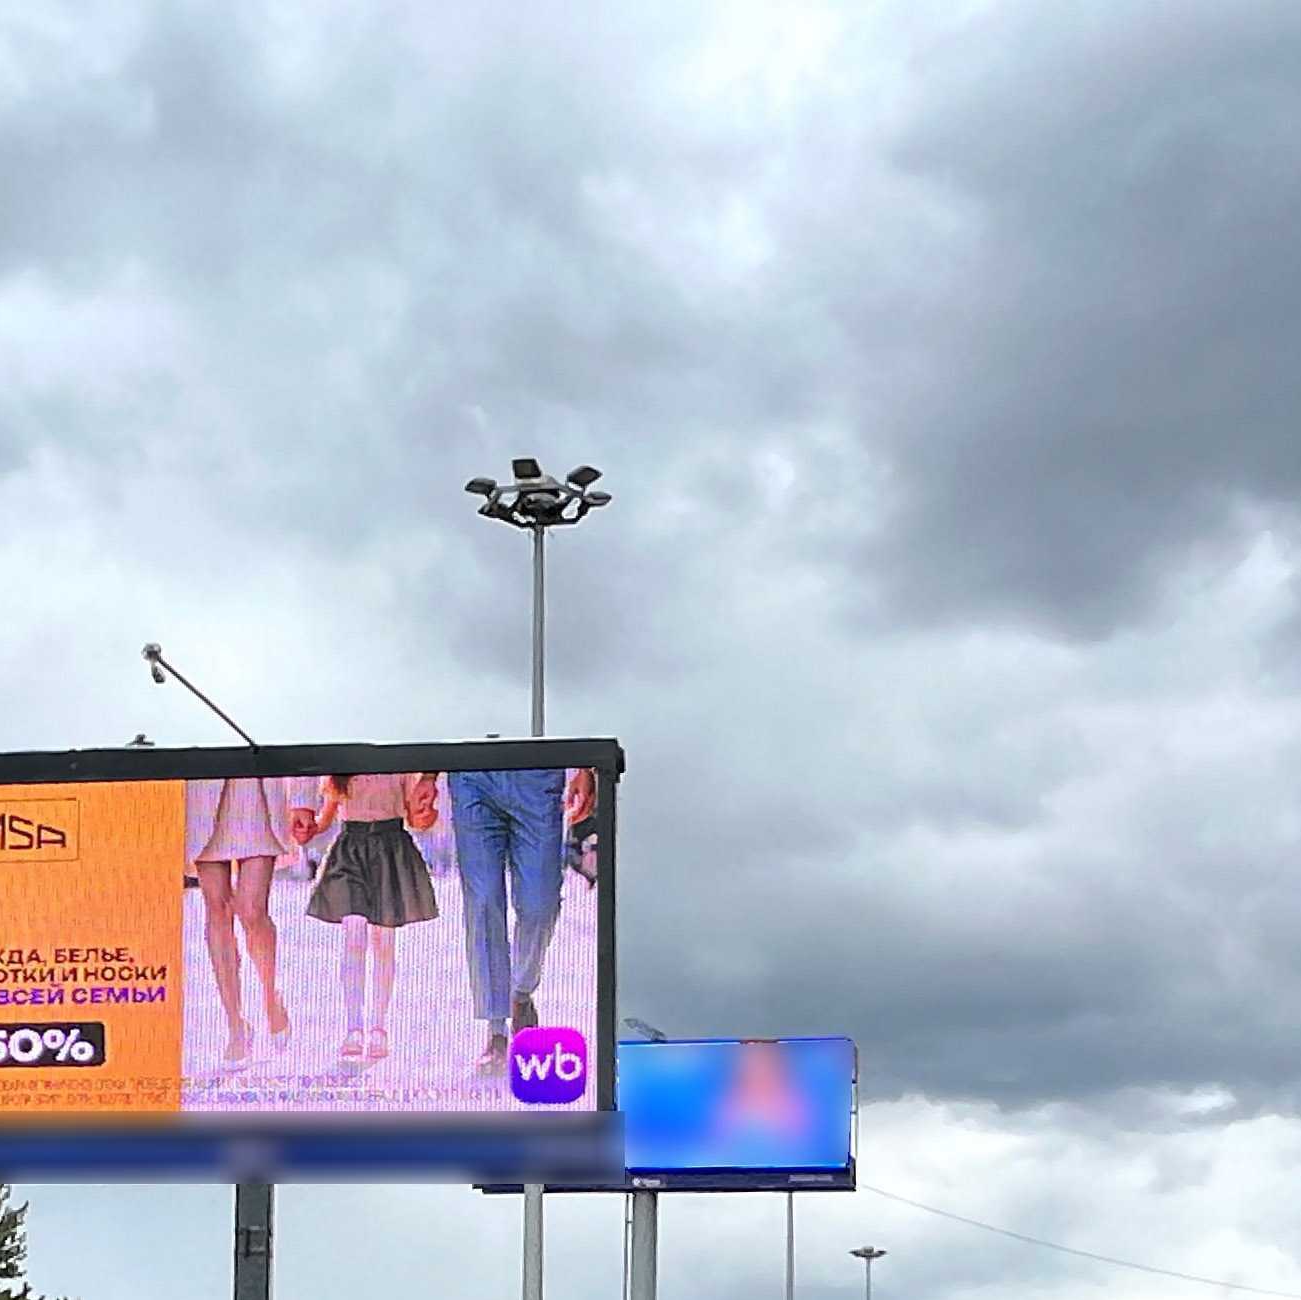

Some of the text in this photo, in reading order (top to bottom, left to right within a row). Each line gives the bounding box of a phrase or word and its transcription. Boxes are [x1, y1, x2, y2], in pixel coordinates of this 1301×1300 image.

[54, 947, 134, 964] БЕЛЬЕ,
[62, 967, 78, 982] И
[84, 965, 167, 982] НОСКИ
[71, 986, 166, 1004] СЕМЬИ
